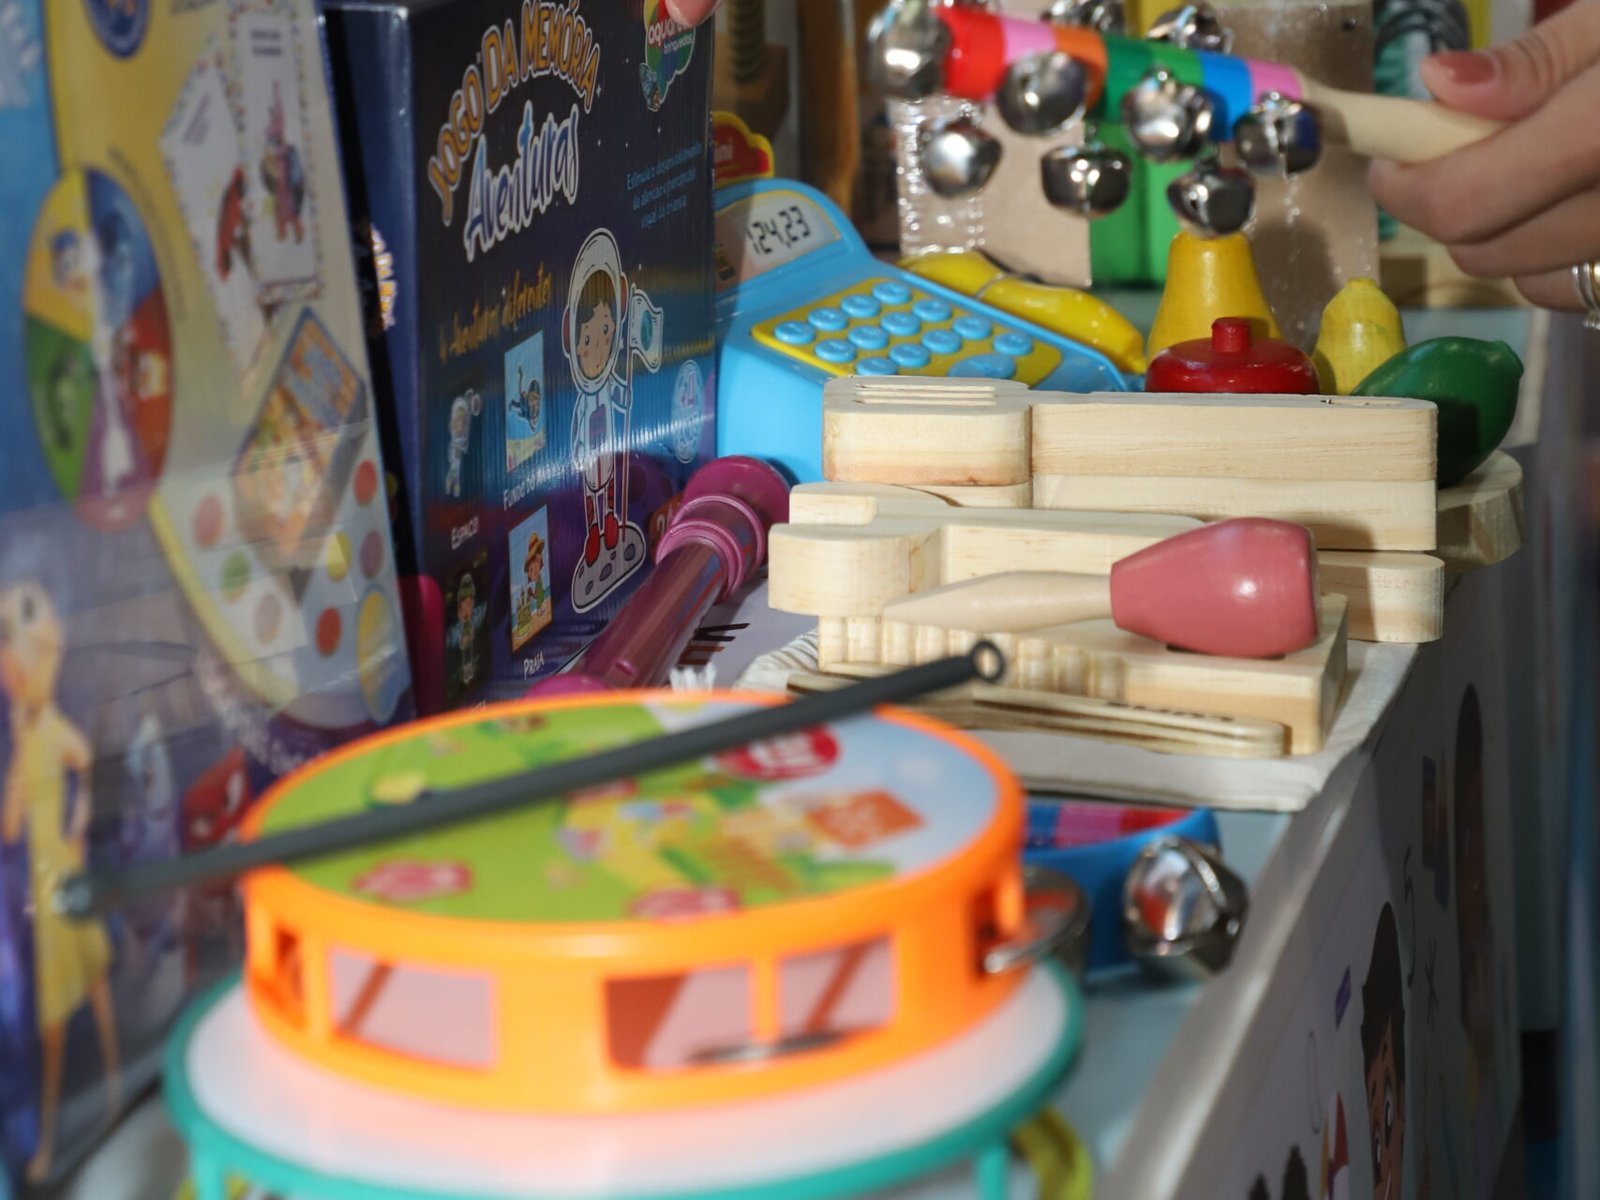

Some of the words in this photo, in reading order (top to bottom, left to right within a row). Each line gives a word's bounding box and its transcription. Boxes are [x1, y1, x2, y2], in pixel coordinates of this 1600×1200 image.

[428, 64, 484, 227] JOGO
[481, 17, 520, 115] DA
[464, 100, 580, 263] Aventuras
[523, 649, 545, 681] PRAIA
